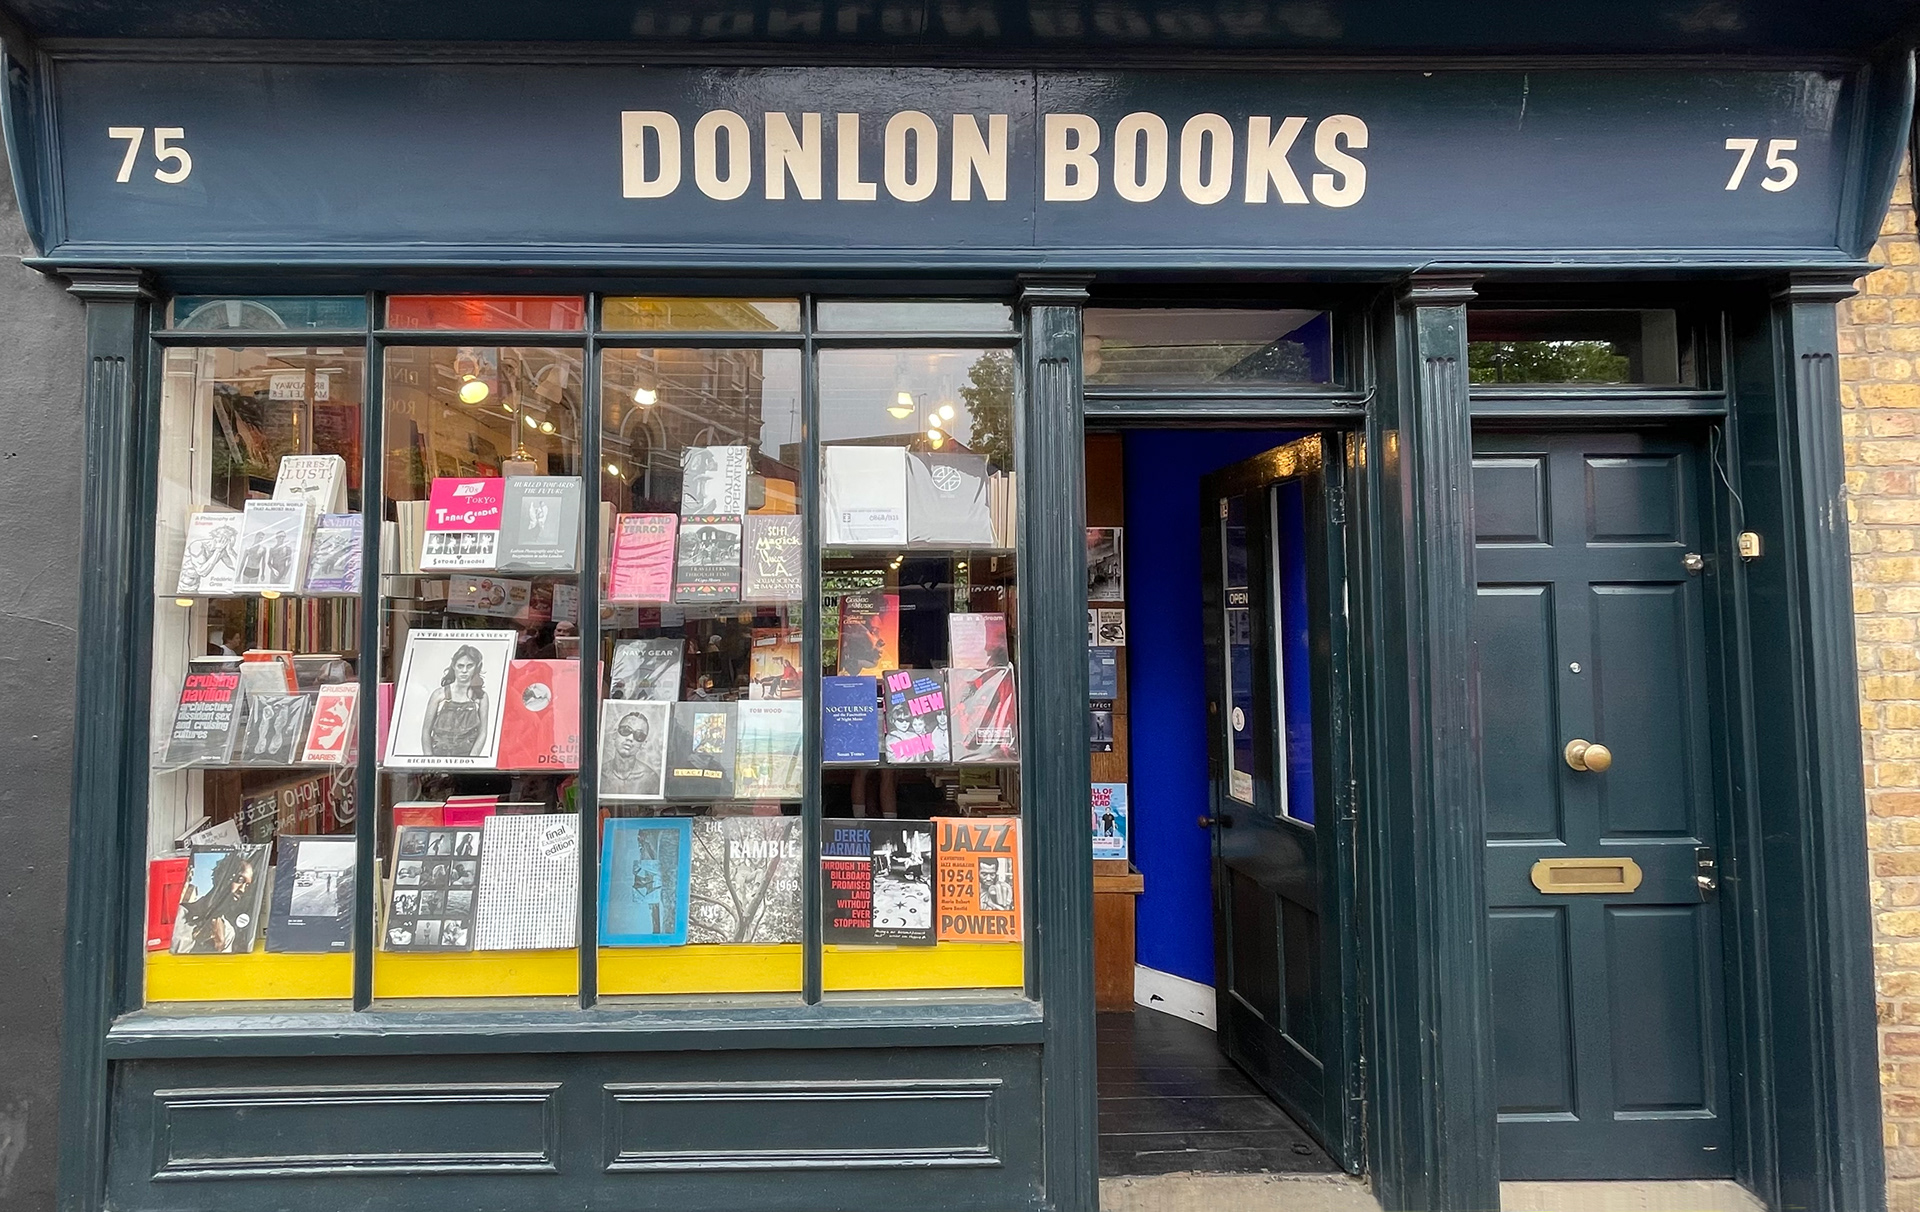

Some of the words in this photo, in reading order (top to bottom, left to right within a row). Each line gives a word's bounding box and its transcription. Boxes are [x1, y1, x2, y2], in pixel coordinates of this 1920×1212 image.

[108, 126, 194, 185] 75
[620, 109, 1009, 202] DONLON
[1044, 111, 1369, 208] BOOKS
[1724, 138, 1799, 193] 75
[295, 460, 325, 468] FIRES
[286, 469, 330, 480] LUST
[619, 516, 645, 525] LOVE
[649, 517, 672, 525] AND
[625, 525, 665, 534] TERROR
[759, 562, 792, 577] L.A.
[1229, 592, 1248, 605] OPEN
[186, 673, 239, 690] cruising
[887, 671, 912, 693] NO
[181, 687, 232, 704] pavilion
[180, 702, 233, 711] architecture
[907, 691, 945, 717] NEW
[178, 711, 214, 720] dissident
[215, 712, 231, 721] sex
[175, 720, 191, 729] and
[193, 721, 229, 731] cruising
[173, 730, 208, 739] cultures
[890, 732, 936, 759] YORK
[545, 825, 566, 841] final
[704, 821, 723, 833] THE
[834, 829, 871, 843] DEREK
[940, 823, 1011, 853] JAZZ
[545, 839, 575, 857] edition
[823, 842, 871, 856] JARMAN
[821, 861, 855, 871] THROUGH
[857, 861, 871, 871] THE
[830, 871, 871, 881] BILLBOARD
[940, 869, 974, 883] 1954
[831, 880, 871, 890] PROMISED
[940, 884, 975, 898] 1974
[851, 890, 871, 900] LAND
[837, 900, 871, 909] WITHOUT
[851, 909, 871, 919] EVER
[833, 919, 871, 928] STOPPING
[941, 914, 1016, 935] POWER!
